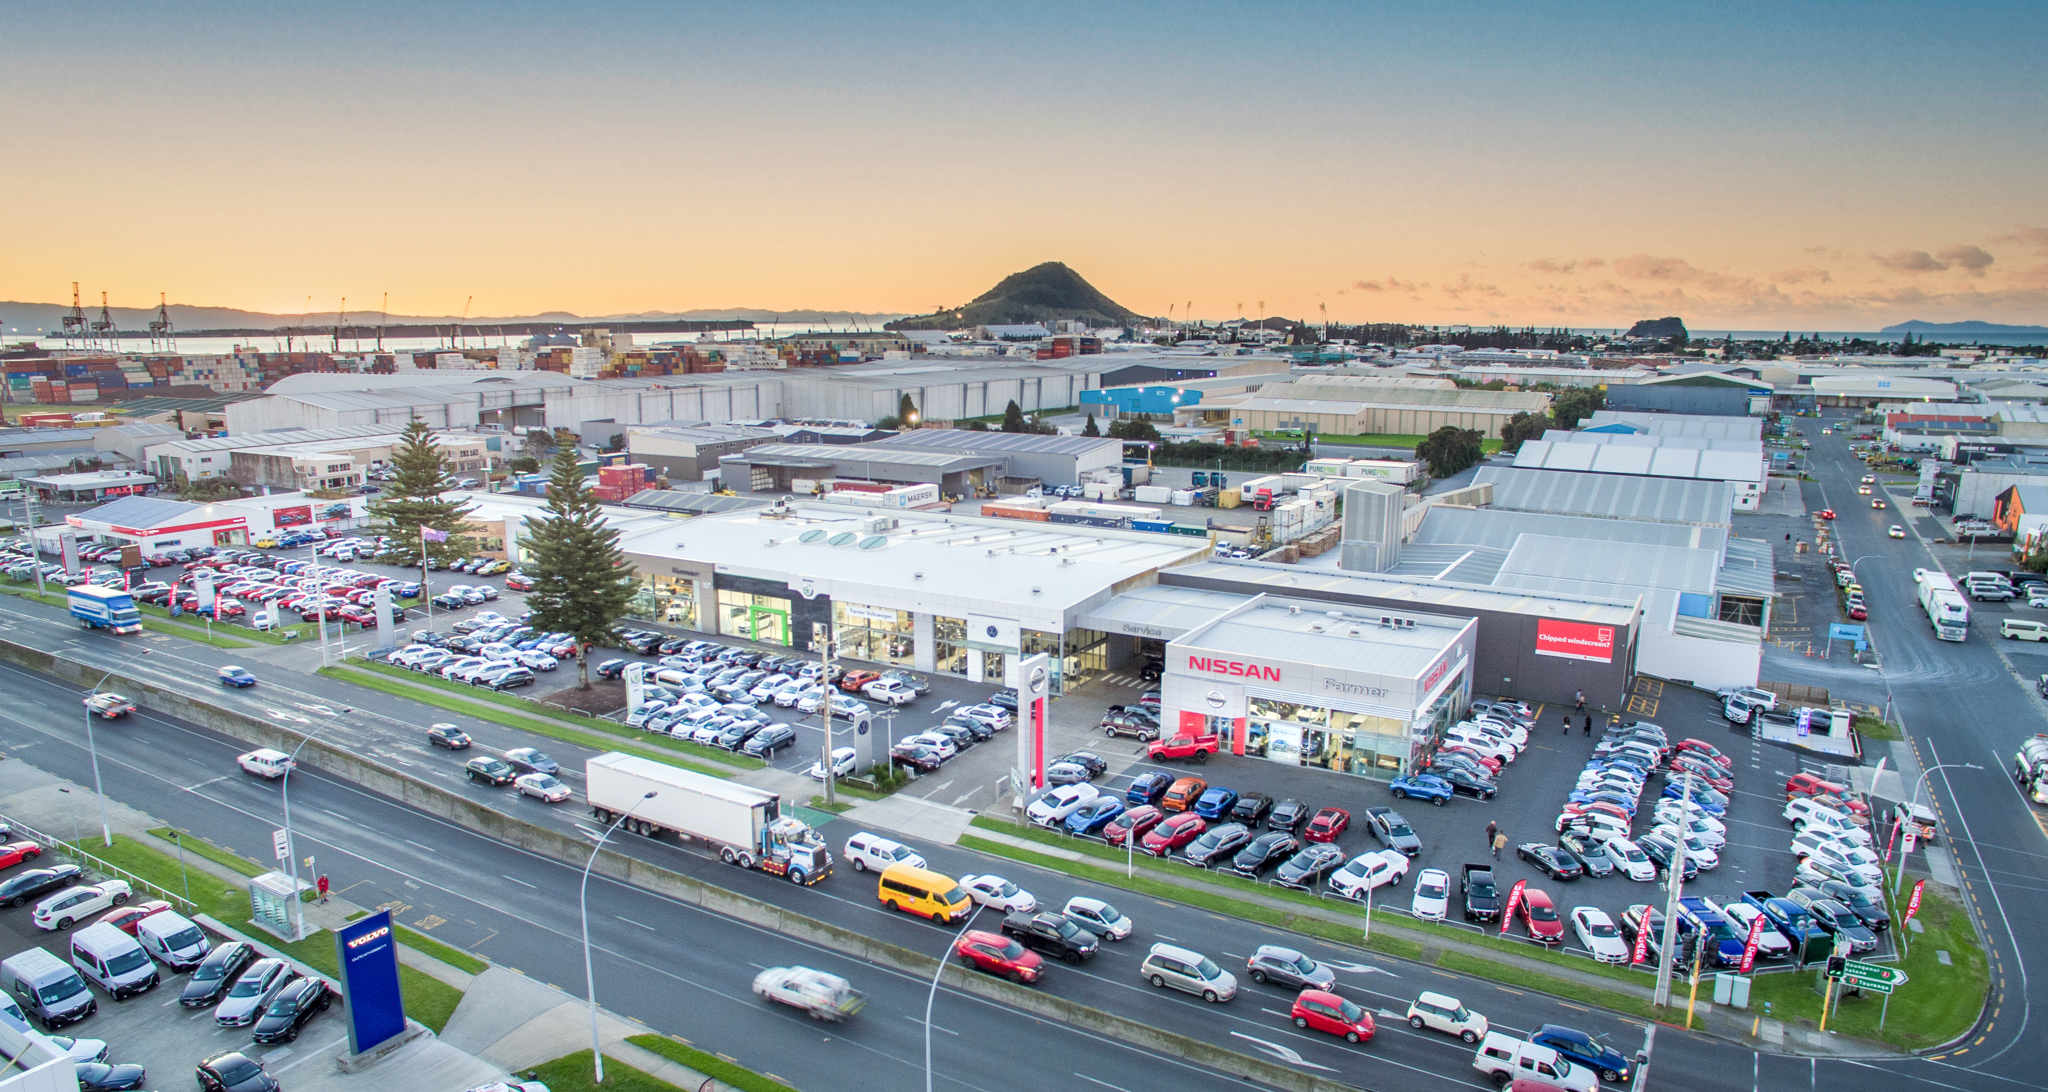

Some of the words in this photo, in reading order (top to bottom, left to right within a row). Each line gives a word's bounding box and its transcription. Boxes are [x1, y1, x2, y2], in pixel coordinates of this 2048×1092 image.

[907, 491, 934, 502] MAERSK
[1123, 624, 1162, 636] Service
[1539, 634, 1567, 643] Chipped
[1567, 638, 1611, 648] windscreen?
[1189, 656, 1281, 682] NISSAN
[1423, 658, 1448, 694] NISSAN
[1323, 678, 1389, 697] Farmer
[1509, 885, 1522, 906] USED
[1910, 885, 1922, 907] USED
[1503, 907, 1514, 929] CARS
[1639, 911, 1649, 935] USED
[347, 926, 389, 948] VOLVO
[1750, 919, 1763, 945] USED
[1635, 937, 1646, 961] CARS
[1743, 946, 1757, 969] CARS
[1859, 980, 1890, 991] Tauranga
